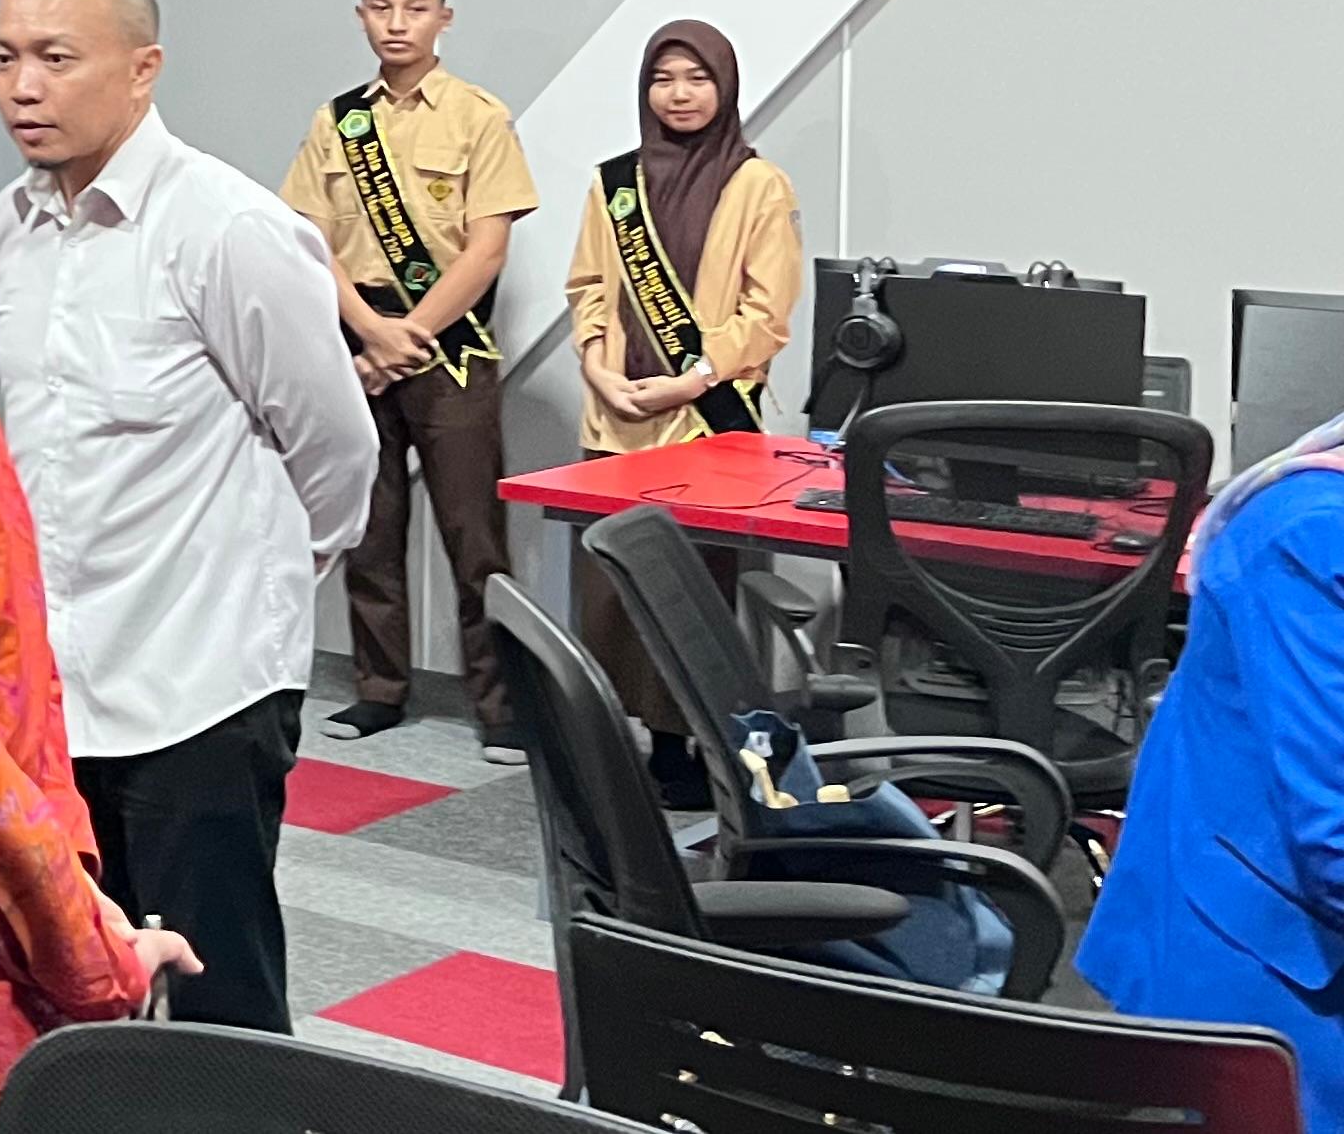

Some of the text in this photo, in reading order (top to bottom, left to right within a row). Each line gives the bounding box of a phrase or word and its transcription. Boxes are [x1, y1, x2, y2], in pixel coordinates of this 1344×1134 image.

[363, 140, 414, 246] Duta Lingkungan
[629, 225, 691, 327] Duta Inspiratif
